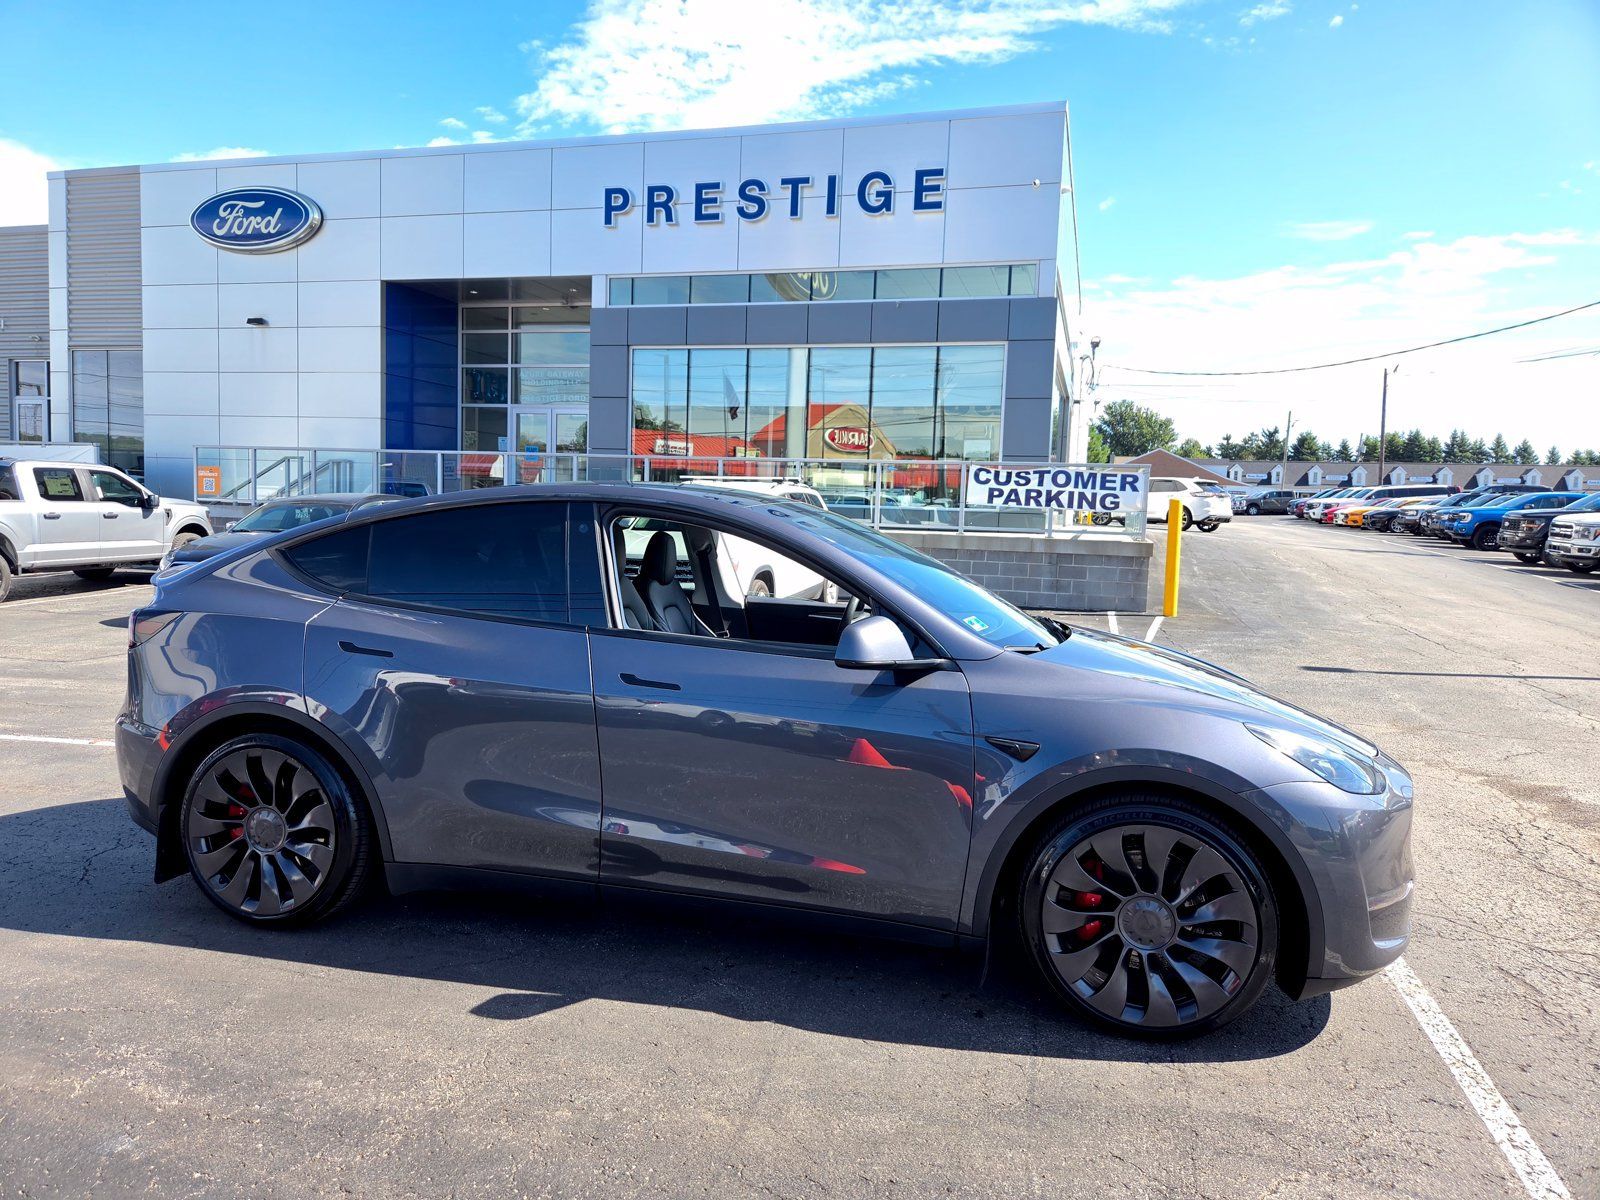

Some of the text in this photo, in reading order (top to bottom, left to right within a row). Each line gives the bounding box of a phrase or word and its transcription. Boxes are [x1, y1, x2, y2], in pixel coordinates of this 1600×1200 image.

[604, 168, 946, 227] PRESTIGE
[212, 200, 283, 236] Ford
[974, 468, 1139, 492] CUSTOMER
[987, 487, 1120, 511] PARKING
[1095, 812, 1153, 826] MICHELIN
